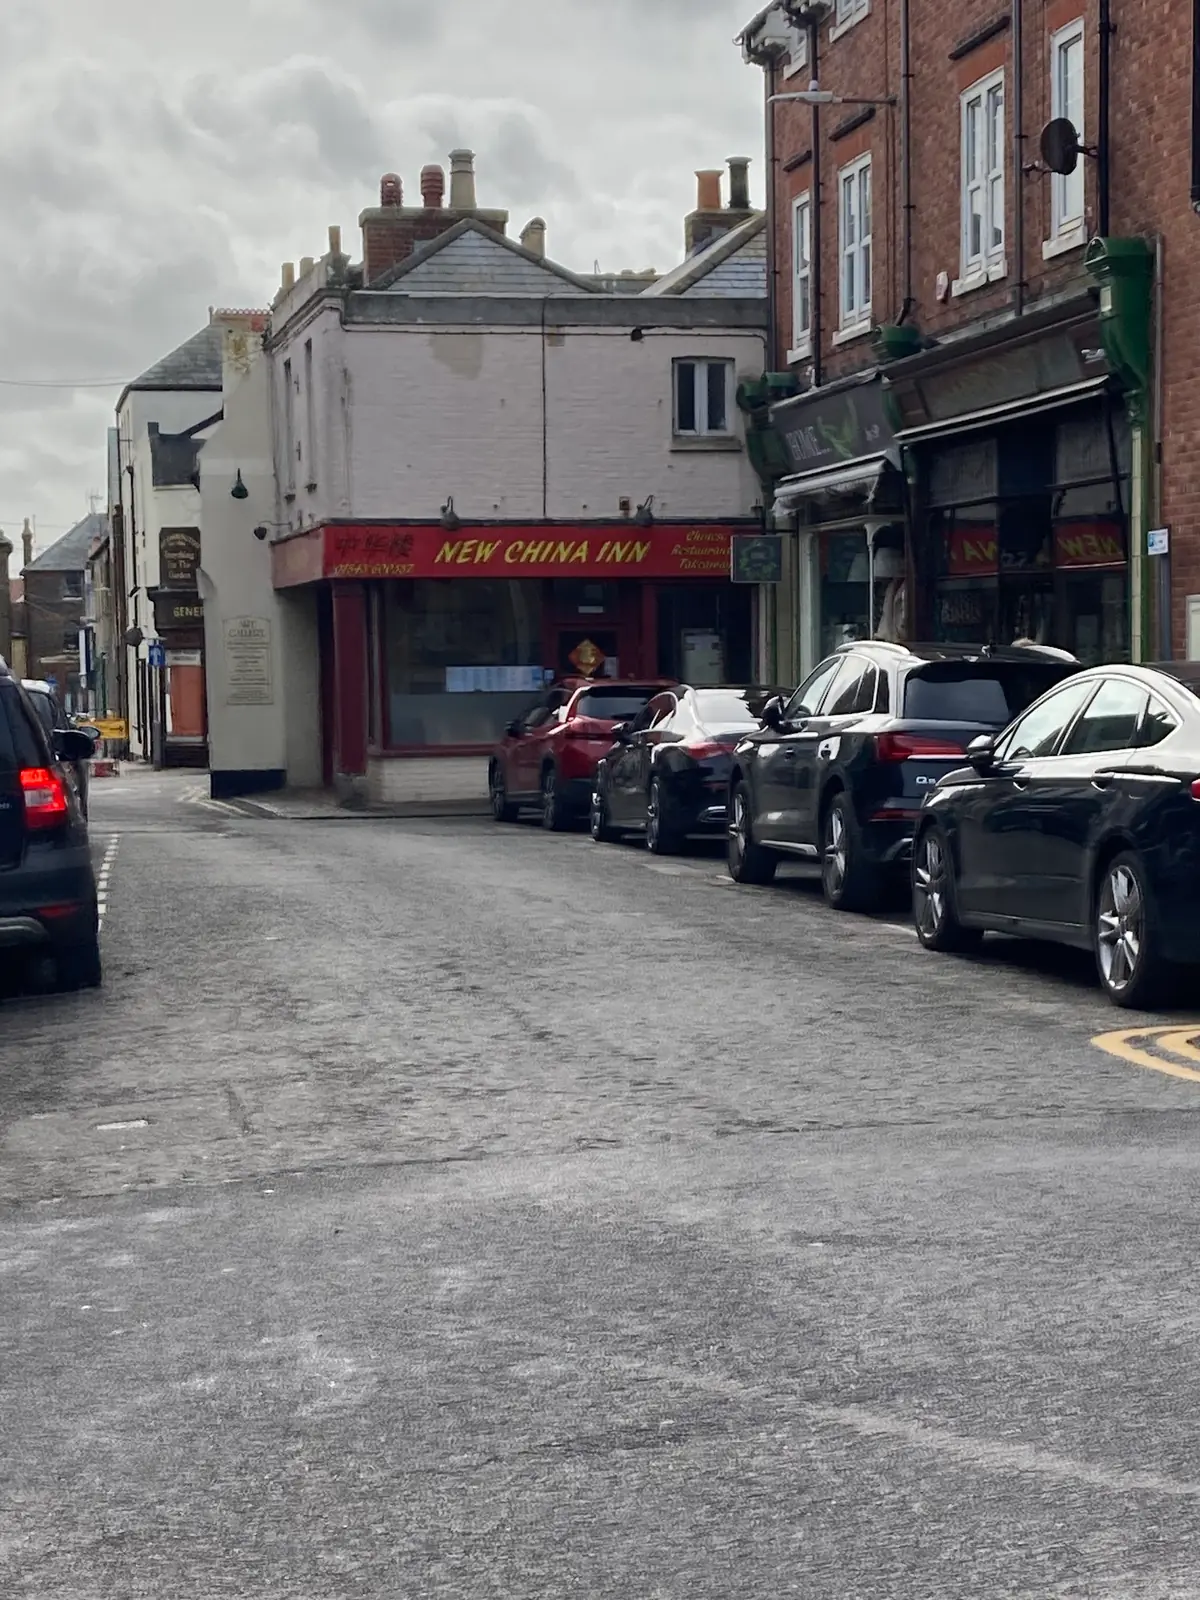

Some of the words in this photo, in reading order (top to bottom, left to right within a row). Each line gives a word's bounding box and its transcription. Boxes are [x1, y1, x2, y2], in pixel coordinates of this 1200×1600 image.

[686, 530, 727, 541] Chinese
[434, 539, 502, 564] NEW
[504, 540, 589, 564] CHINA
[595, 540, 652, 563] INN
